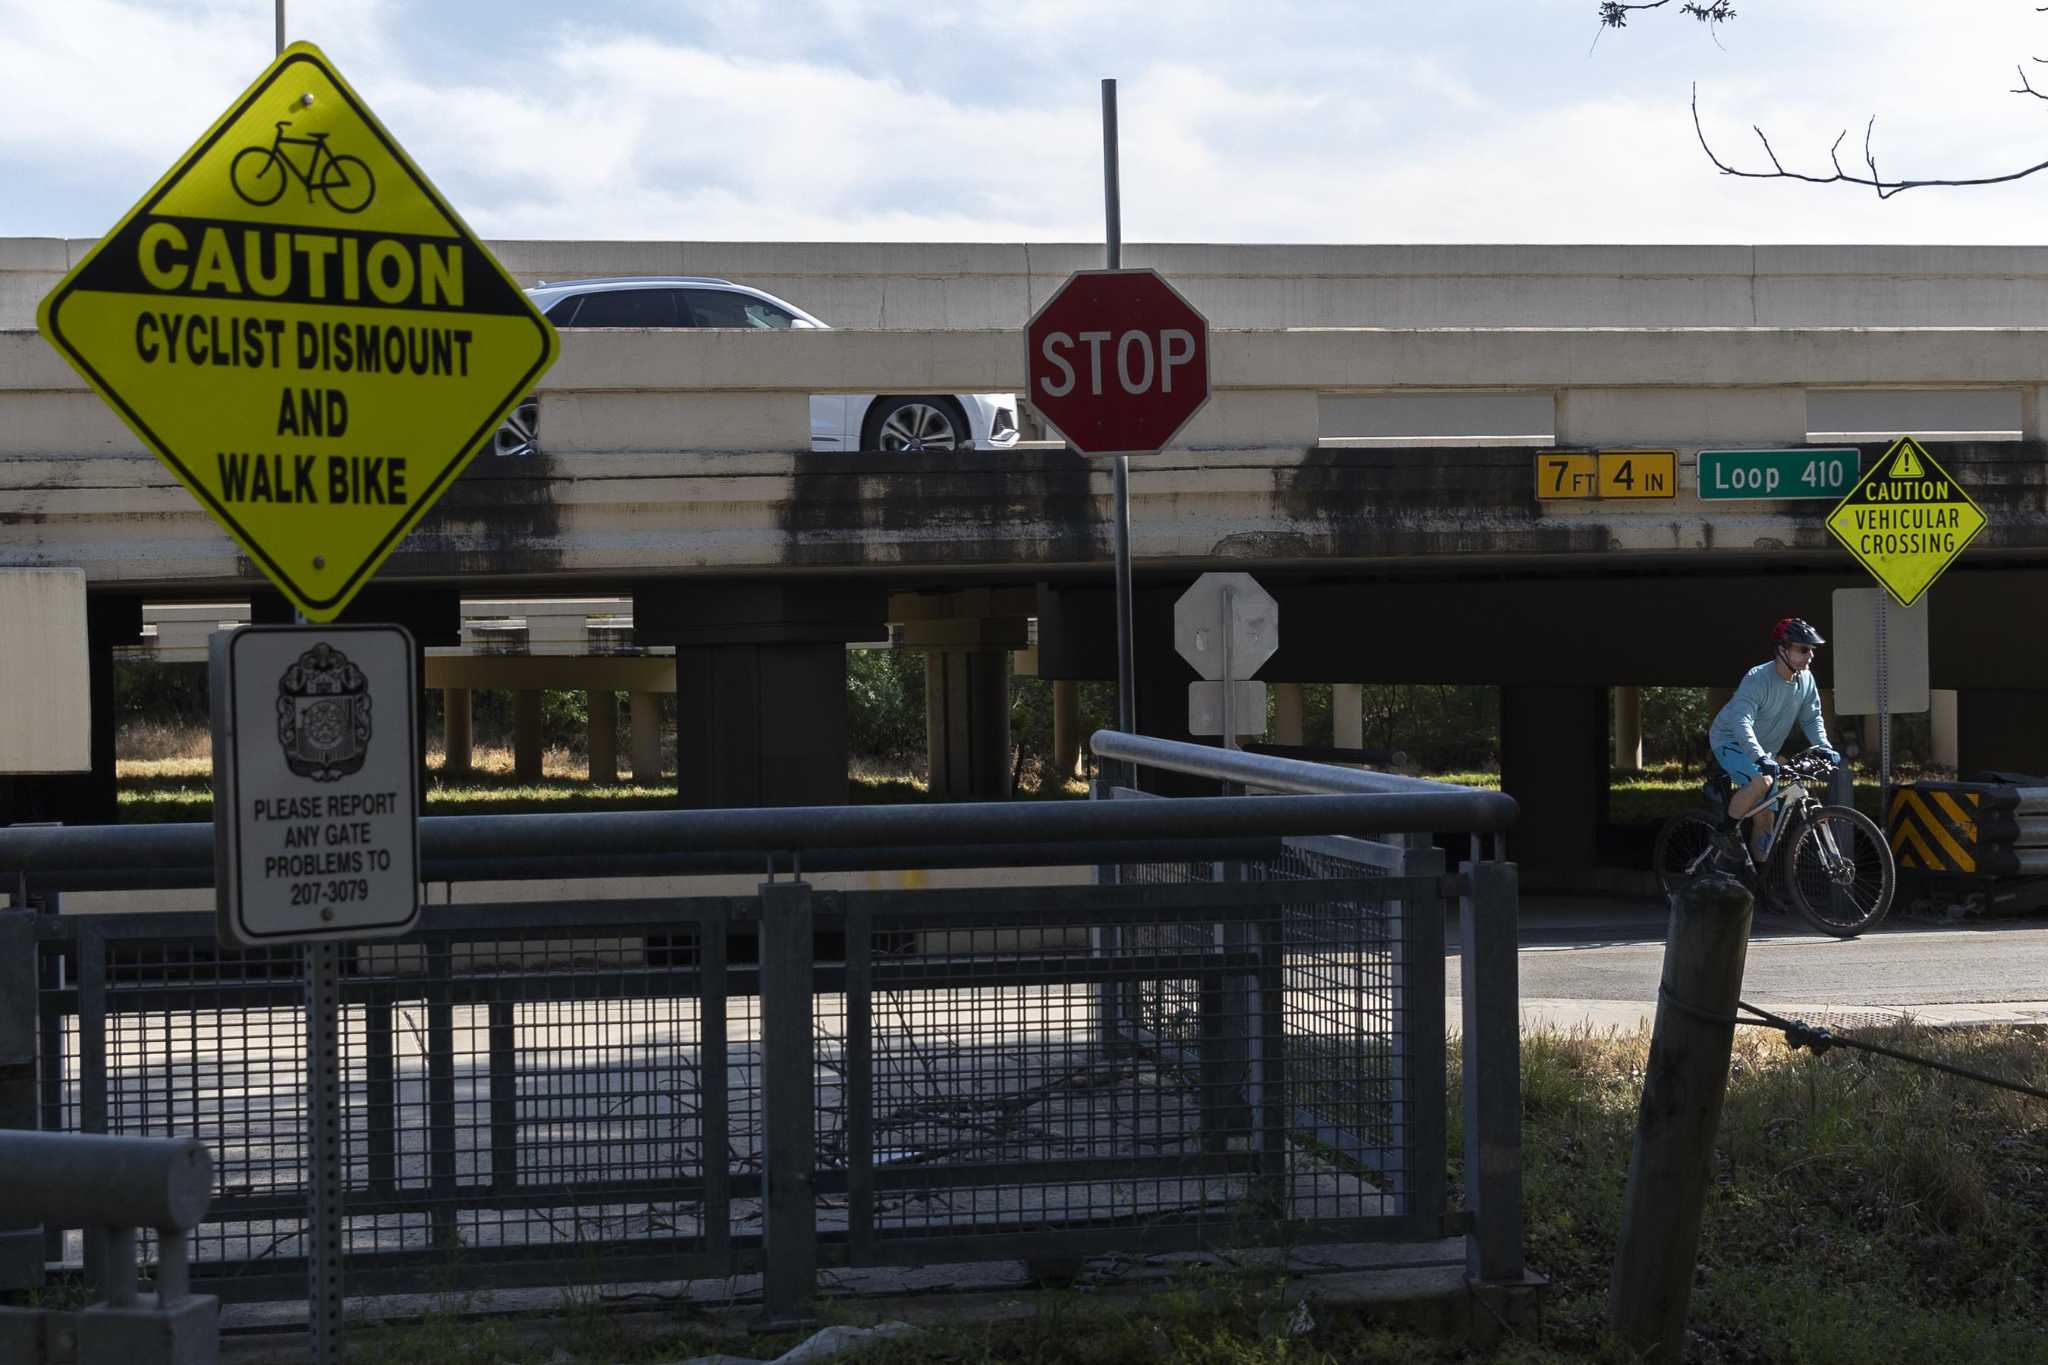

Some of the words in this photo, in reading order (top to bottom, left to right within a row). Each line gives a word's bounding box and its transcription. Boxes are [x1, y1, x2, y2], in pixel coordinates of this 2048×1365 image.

[137, 222, 465, 307] CAUTION
[135, 311, 285, 368] CYCLIST
[296, 320, 472, 377] DISMOUNT
[1040, 328, 1196, 397] STOP
[277, 387, 348, 437] AND
[218, 452, 319, 504] WALK
[328, 457, 407, 505] BIKE
[1548, 461, 1569, 491] 7
[1572, 473, 1595, 492] FT
[1612, 460, 1635, 490] 4
[1645, 473, 1664, 491] IN
[1715, 462, 1780, 493] Loop
[1801, 461, 1844, 488] 410
[1866, 481, 1949, 501] CAUTION
[1855, 508, 1960, 530] VEHICULAR
[1860, 532, 1955, 555] CROSSING
[254, 797, 323, 820] PLEASE
[328, 792, 397, 816] REPORT
[284, 825, 319, 848] ANY
[325, 822, 371, 846] GATE
[265, 852, 363, 879] PROBLEMS
[368, 849, 390, 872] TO
[291, 879, 368, 905] 207-3079
